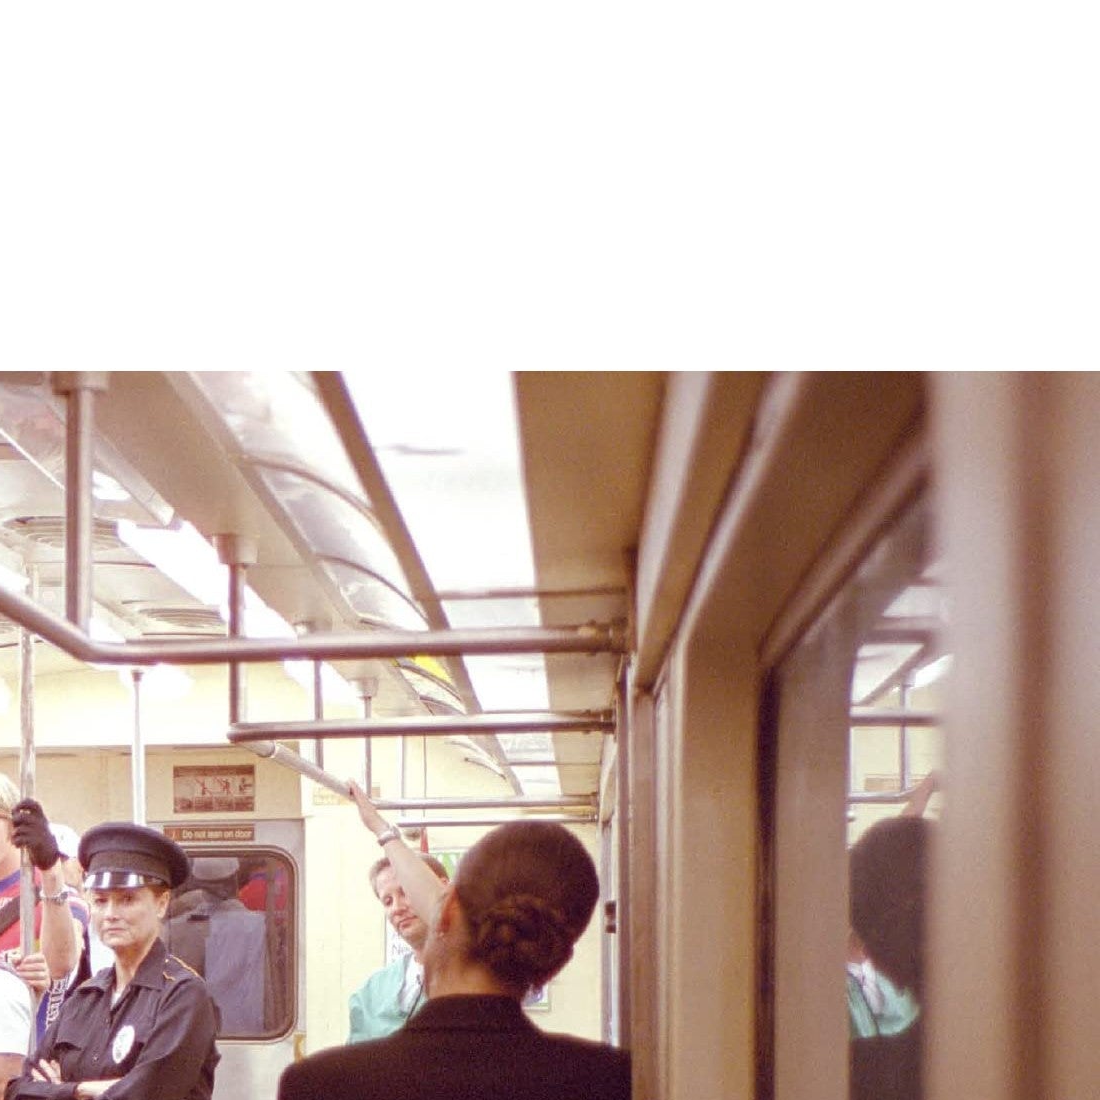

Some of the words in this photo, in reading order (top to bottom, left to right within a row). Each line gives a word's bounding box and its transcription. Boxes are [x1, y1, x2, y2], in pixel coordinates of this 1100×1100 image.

[182, 829, 193, 839] Do
[194, 830, 206, 839] not
[223, 830, 234, 839] on
[234, 828, 252, 839] door
